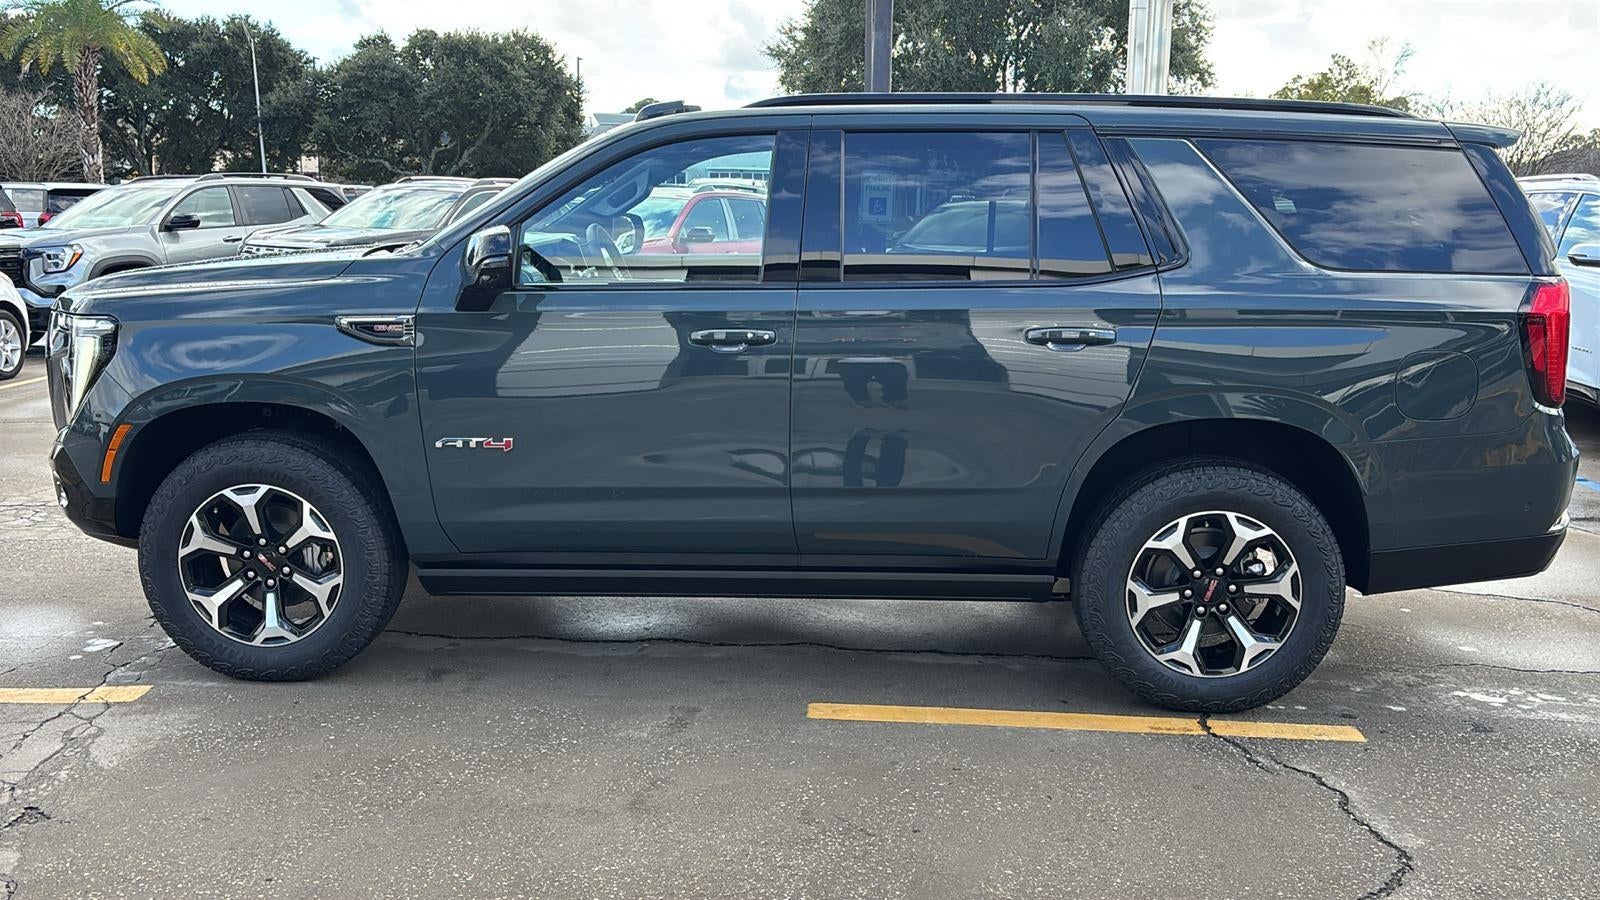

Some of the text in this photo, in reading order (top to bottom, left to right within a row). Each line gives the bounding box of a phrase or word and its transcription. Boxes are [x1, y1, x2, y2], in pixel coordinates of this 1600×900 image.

[373, 324, 403, 332] GMC
[435, 437, 514, 452] AT4
[257, 553, 277, 572] GMC
[1203, 579, 1218, 602] GMC
